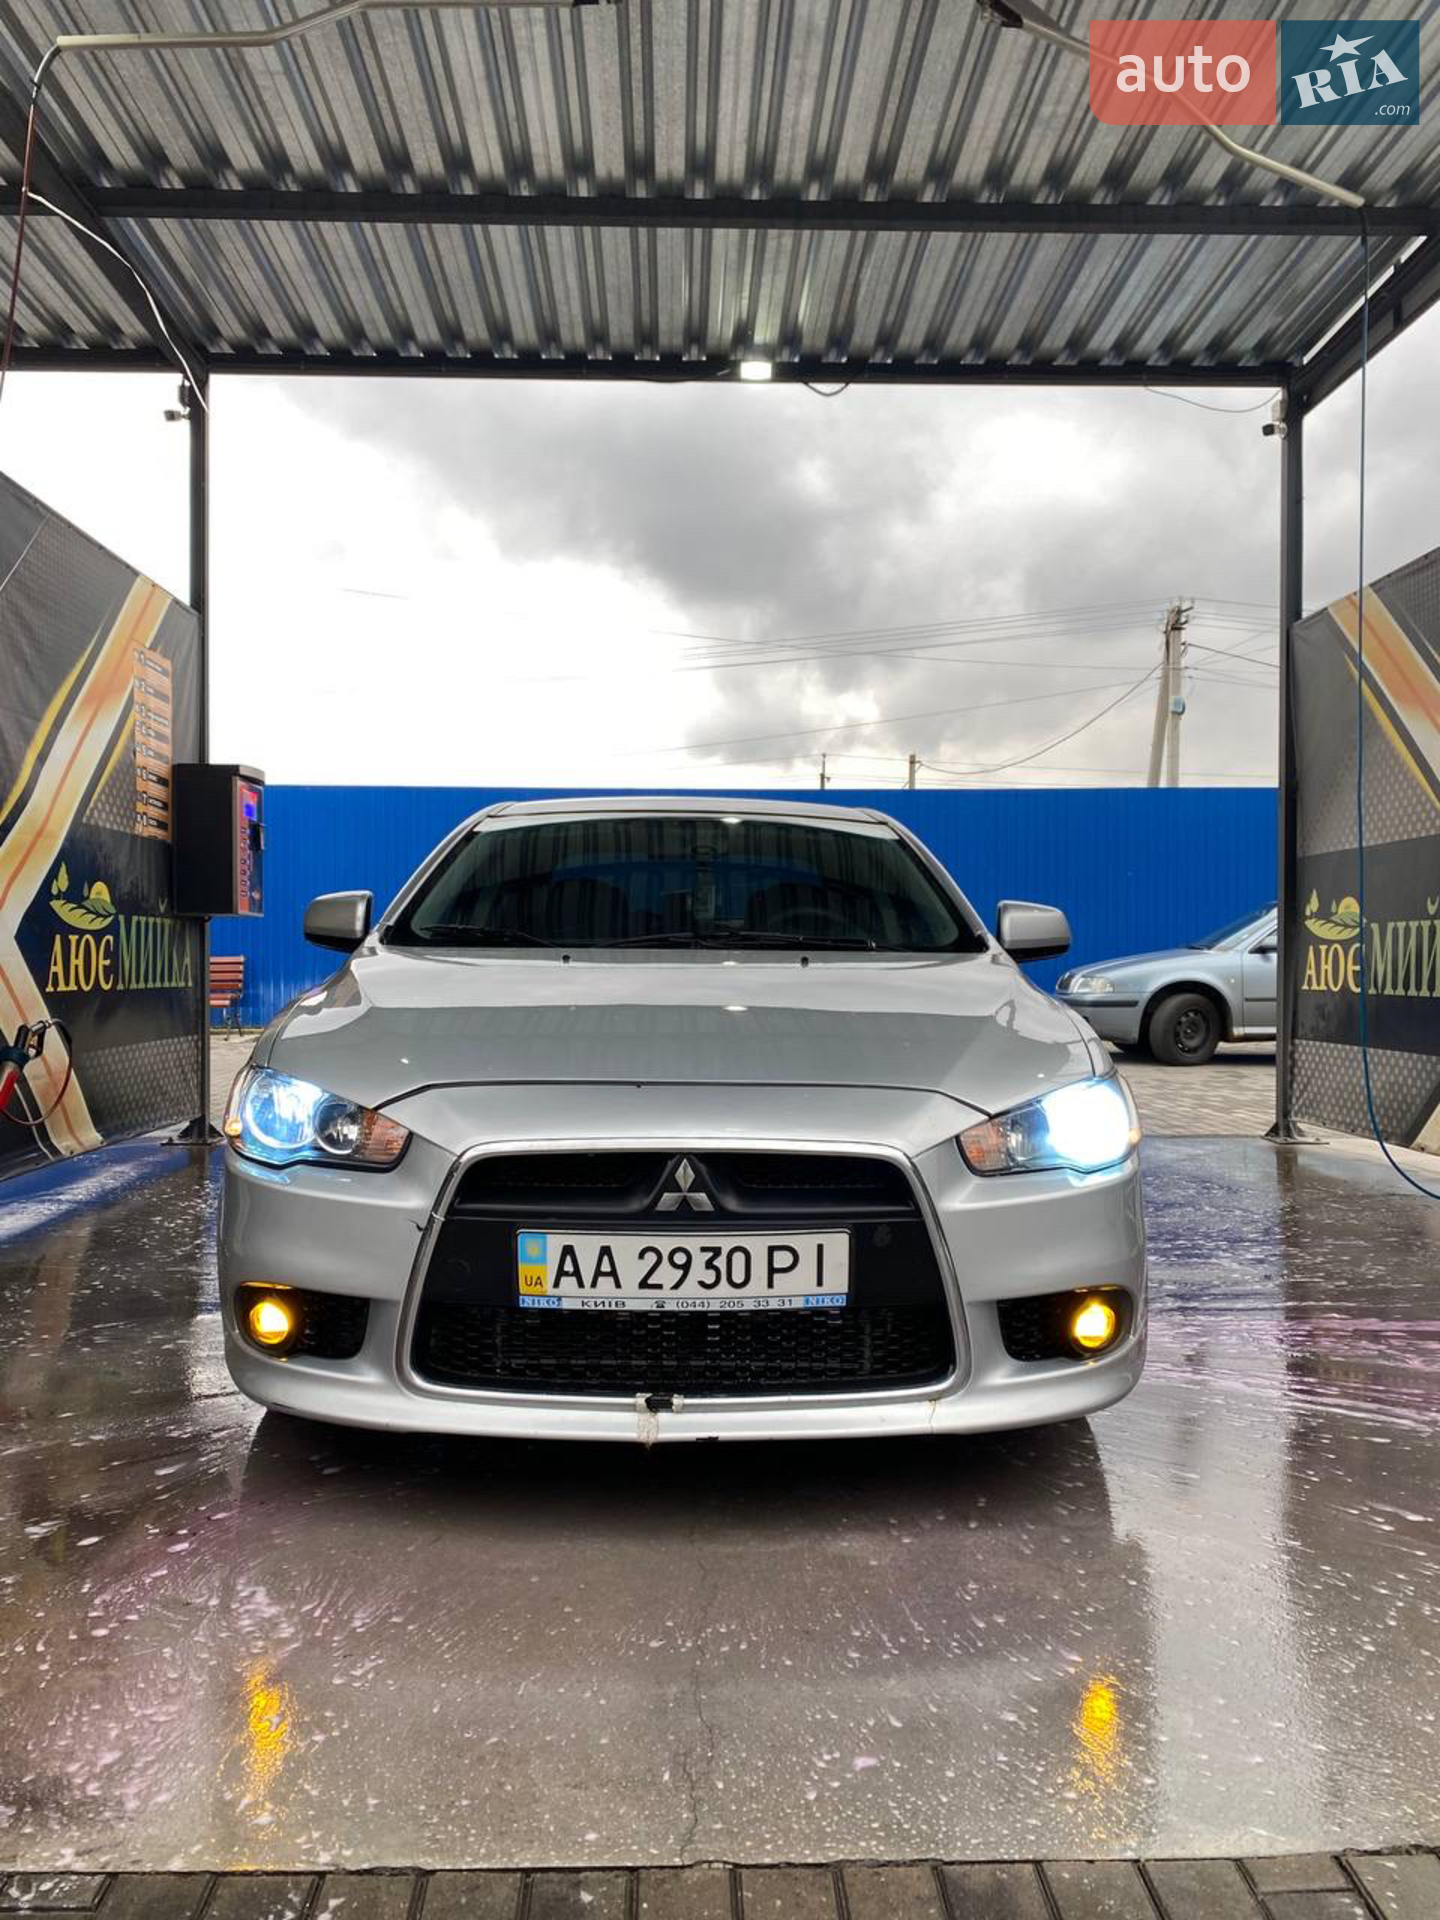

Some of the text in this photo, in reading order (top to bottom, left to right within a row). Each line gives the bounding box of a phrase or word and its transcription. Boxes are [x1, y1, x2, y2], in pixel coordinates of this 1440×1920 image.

[637, 1246, 752, 1290] 2930
[523, 1275, 544, 1288] UA
[719, 1299, 744, 1308] 205
